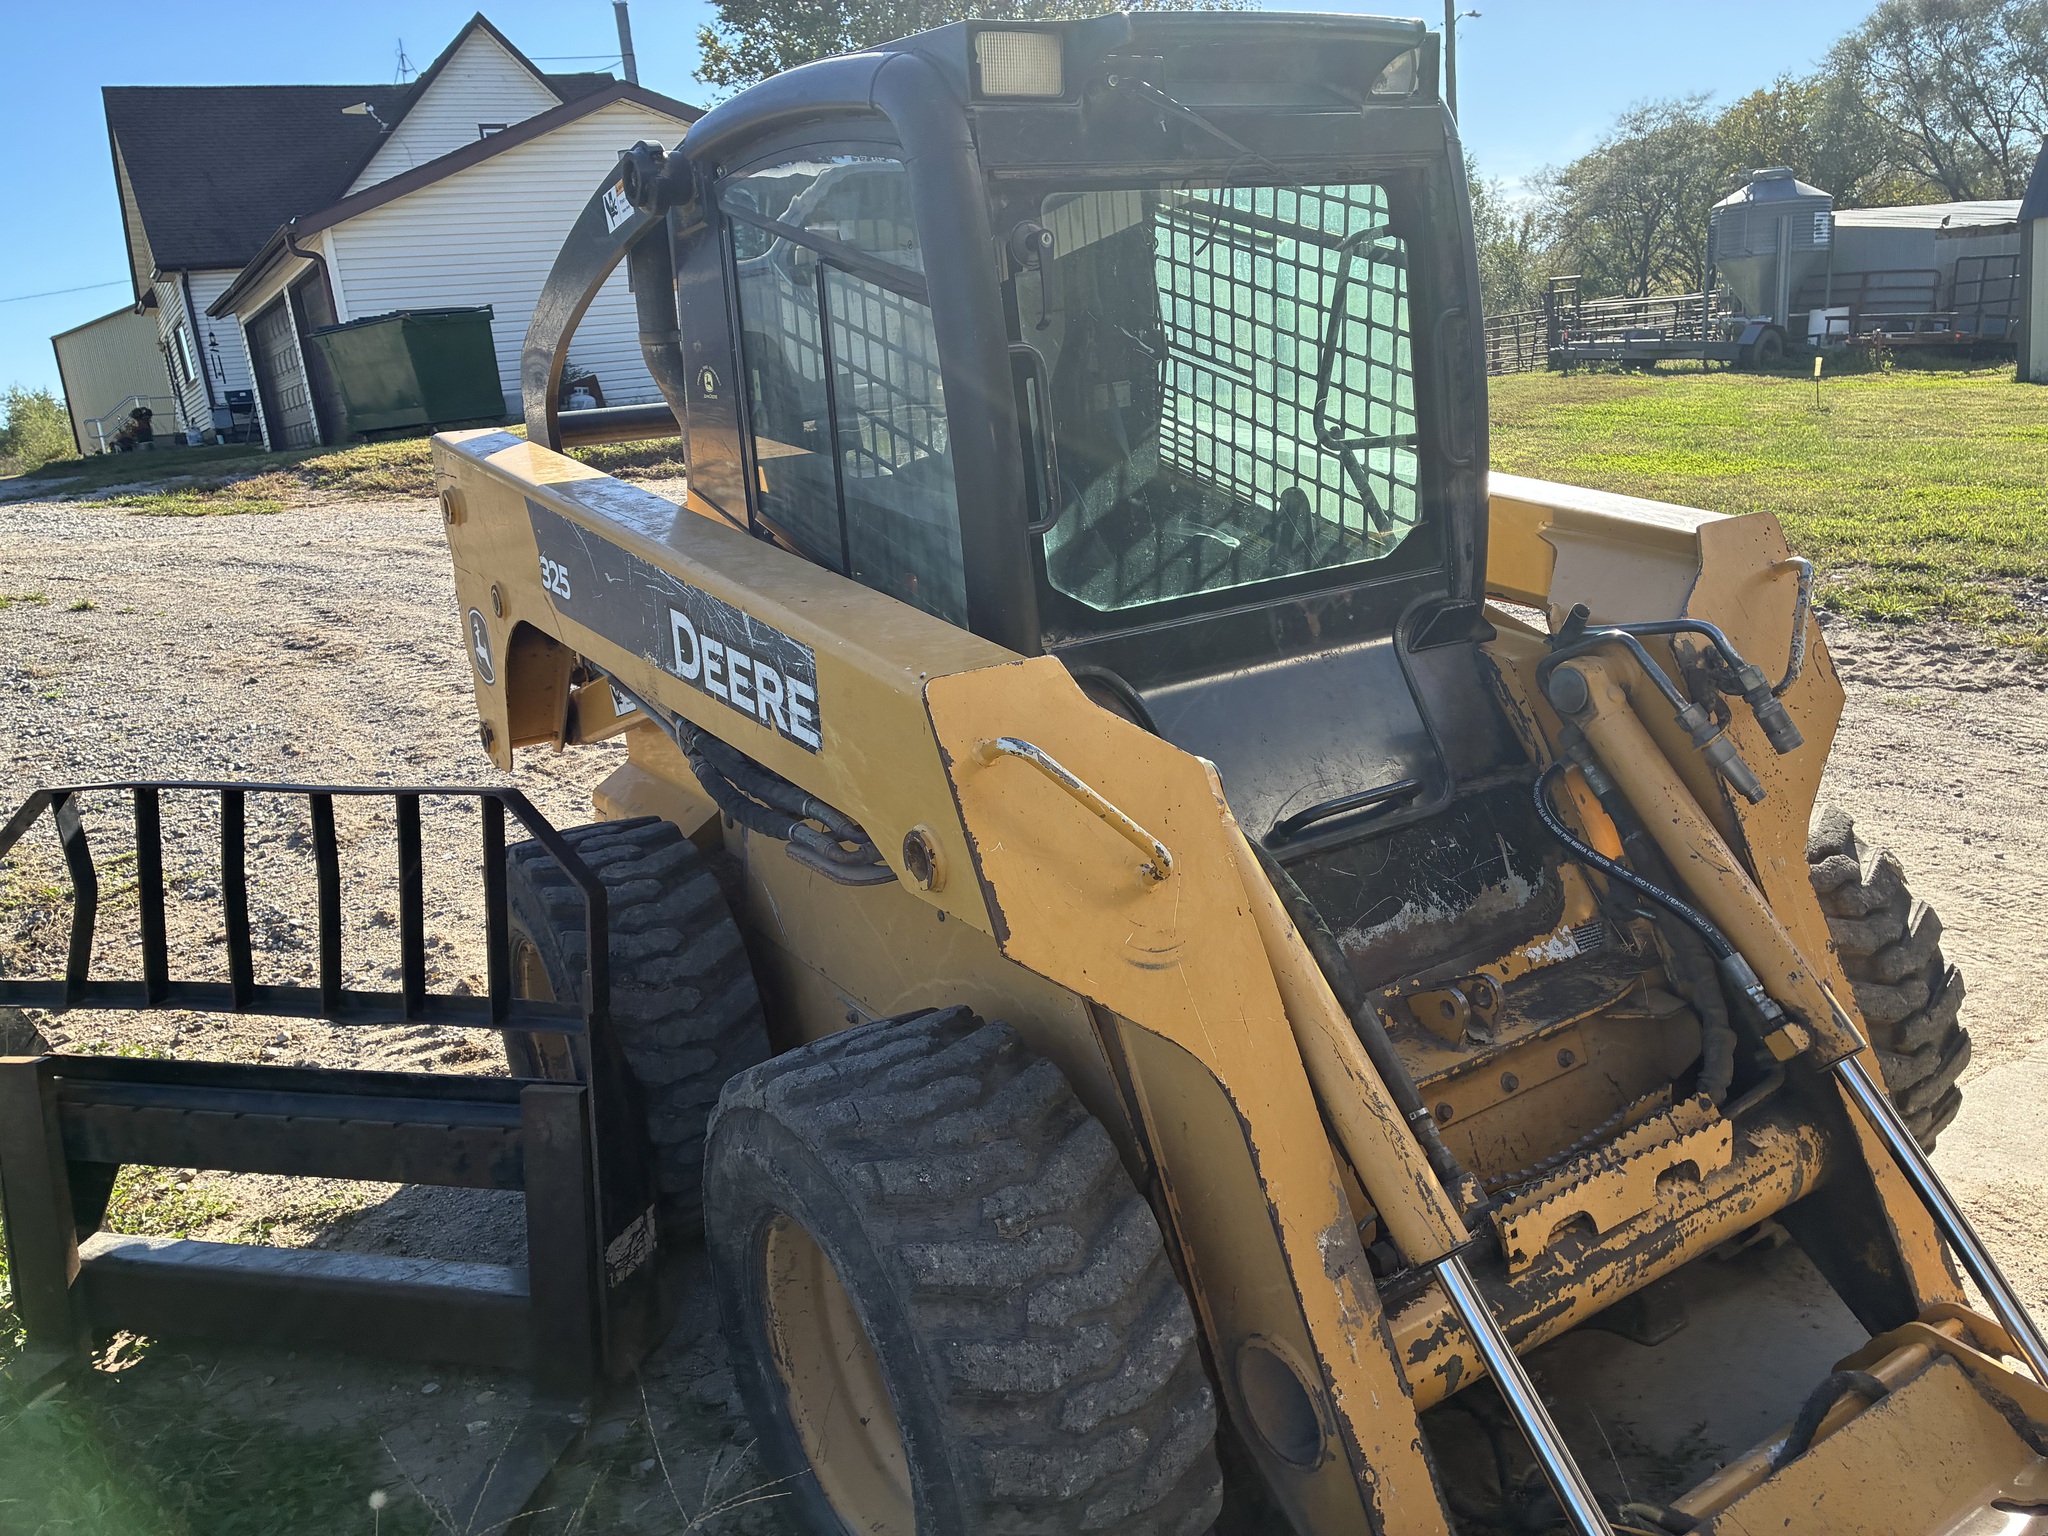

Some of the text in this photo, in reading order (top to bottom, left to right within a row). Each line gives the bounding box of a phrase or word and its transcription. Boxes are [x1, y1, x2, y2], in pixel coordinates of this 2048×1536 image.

[540, 555, 571, 600] 325
[670, 608, 821, 749] DEERE
[1571, 840, 1588, 854] MSHA
